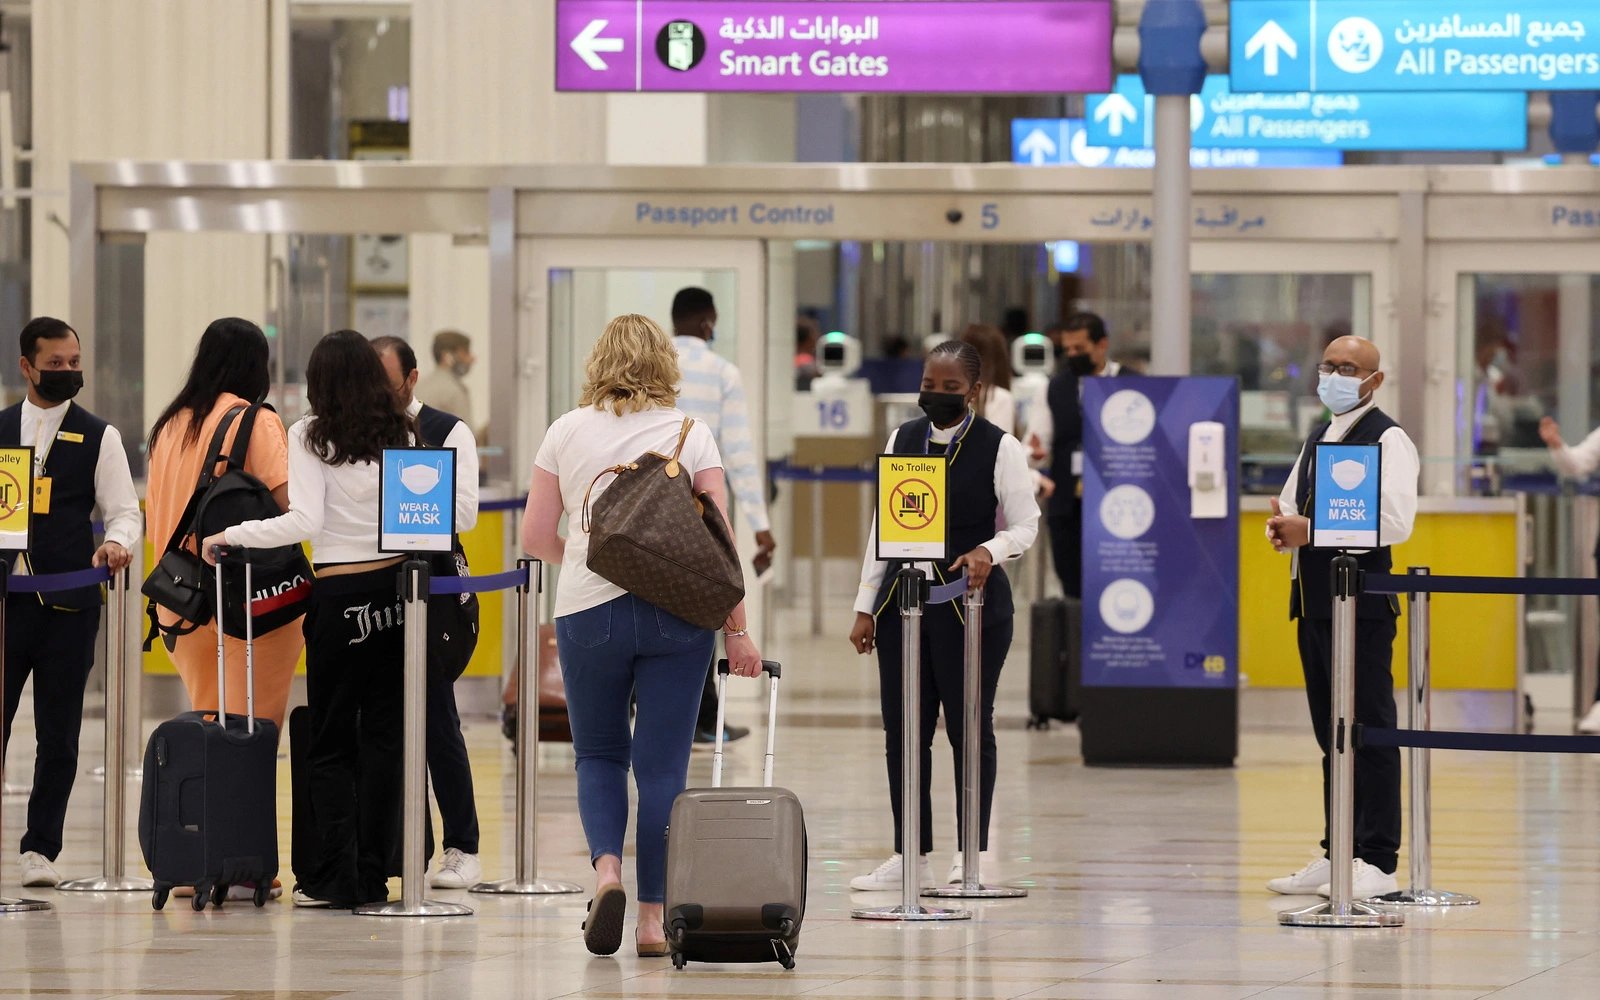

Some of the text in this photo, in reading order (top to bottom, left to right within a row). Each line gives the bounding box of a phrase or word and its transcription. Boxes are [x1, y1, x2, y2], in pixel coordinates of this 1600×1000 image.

[719, 15, 879, 45] البوابات الذكية
[1395, 13, 1586, 48] جميع المسافرين
[719, 49, 889, 76] Smart Gates
[1395, 48, 1600, 81] All Passengers
[1210, 115, 1371, 144] All Passengers
[636, 202, 834, 229] Passport Control
[981, 203, 1000, 230] 5
[1552, 205, 1600, 227] Pas
[816, 400, 849, 430] 16
[0, 454, 20, 464] olley
[891, 463, 937, 473] No Trolley
[400, 502, 439, 511] WEAR A
[1328, 508, 1366, 520] MASK
[1329, 498, 1366, 507] WEAR A
[399, 512, 440, 524] MASK
[343, 594, 405, 645] Jui
